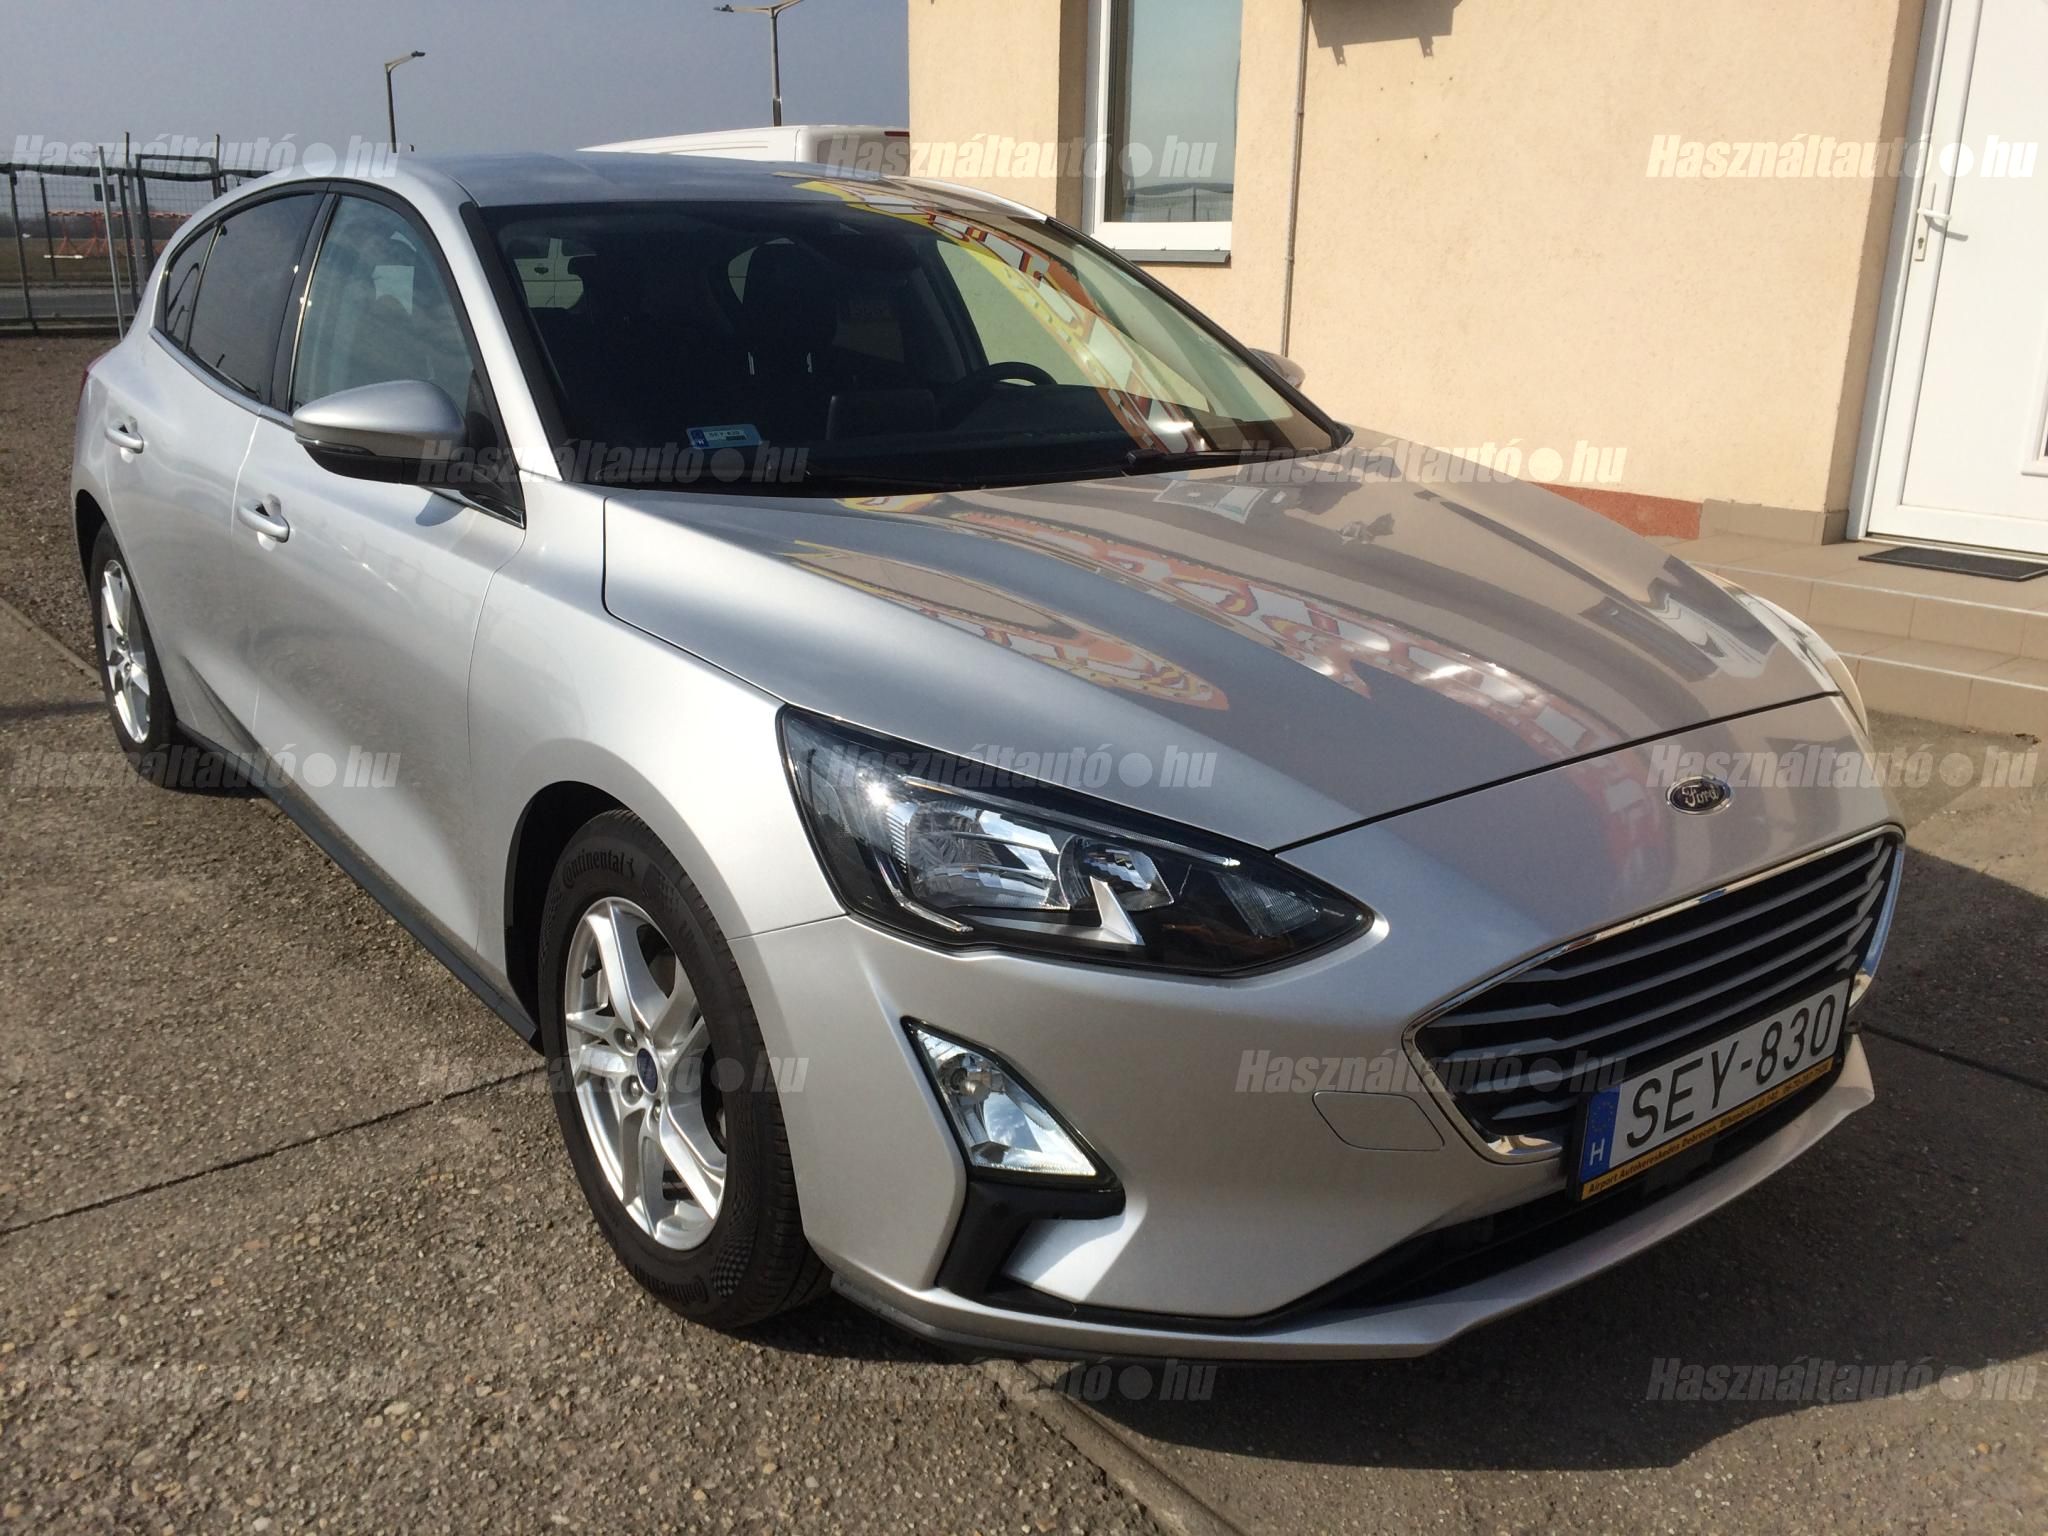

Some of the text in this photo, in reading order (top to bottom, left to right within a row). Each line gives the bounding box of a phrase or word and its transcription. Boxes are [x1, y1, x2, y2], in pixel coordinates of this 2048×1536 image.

[1681, 784, 1720, 808] Ford
[562, 848, 625, 889] Continental
[1626, 994, 1836, 1149] SEY-830
[1589, 1137, 1606, 1166] H
